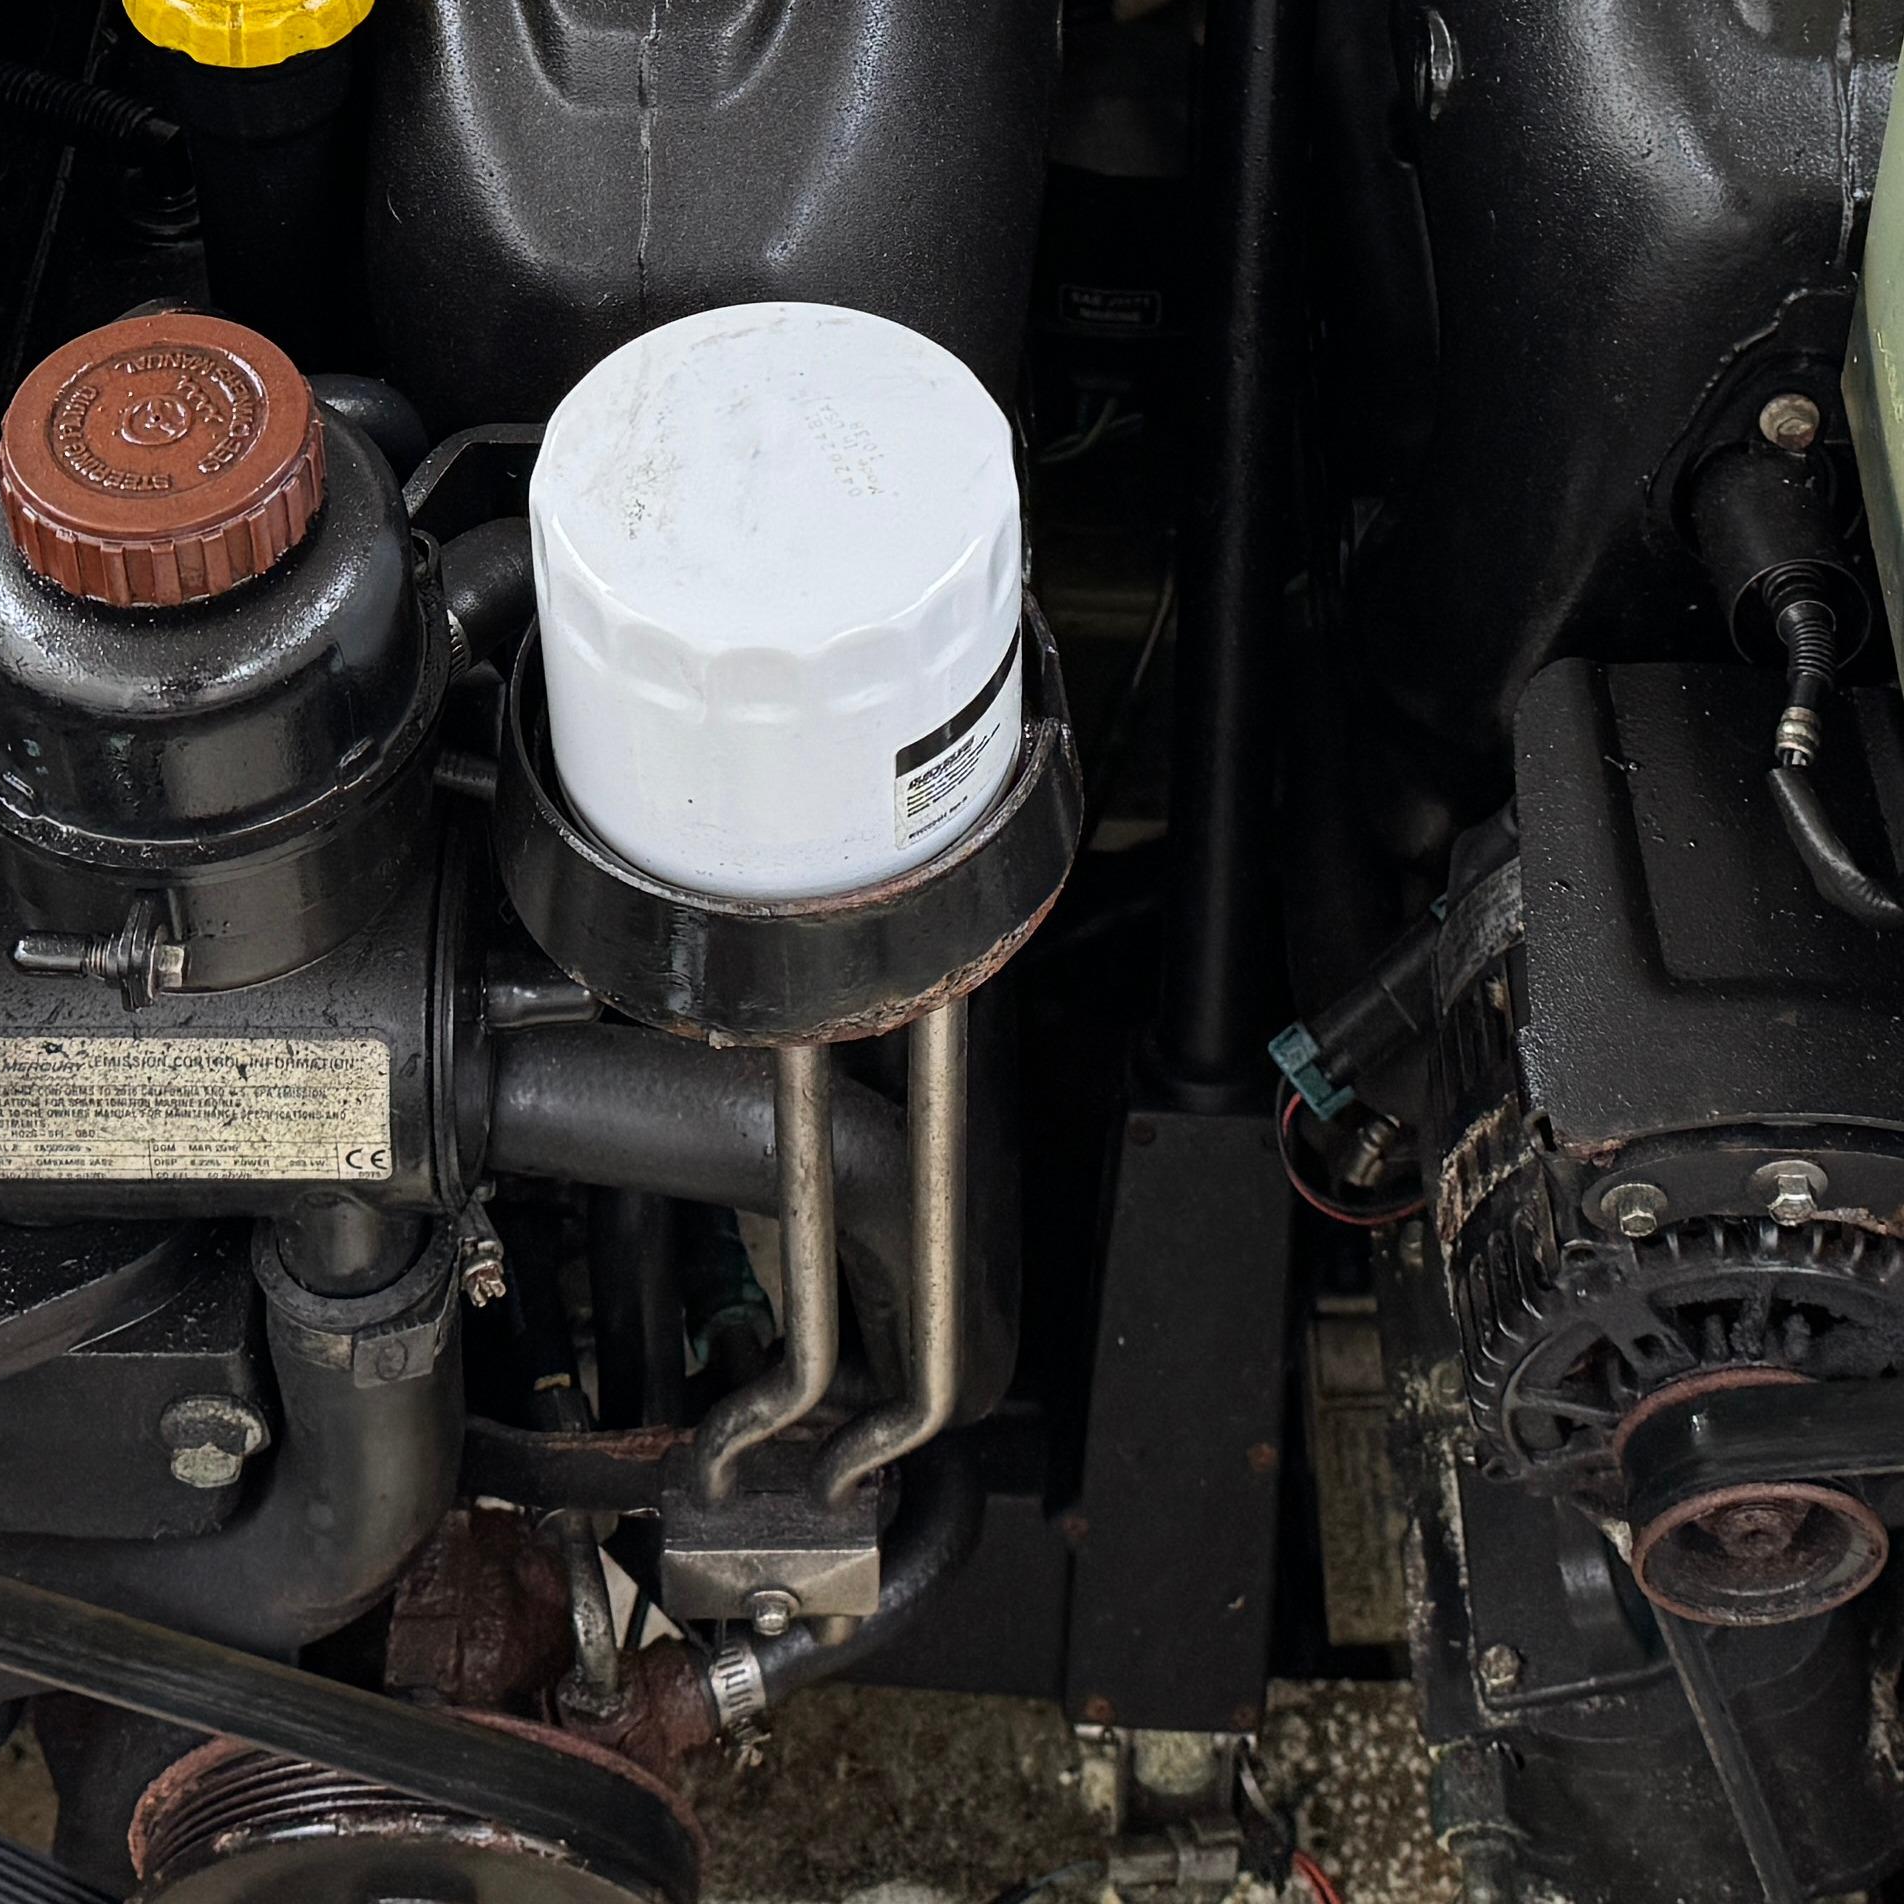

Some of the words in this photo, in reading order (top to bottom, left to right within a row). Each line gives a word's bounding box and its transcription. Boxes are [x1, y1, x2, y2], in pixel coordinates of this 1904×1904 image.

[114, 352, 216, 375] MANUAL
[59, 385, 99, 442] FLUID
[64, 444, 173, 491] STEERING
[95, 1053, 167, 1070] EMISSION
